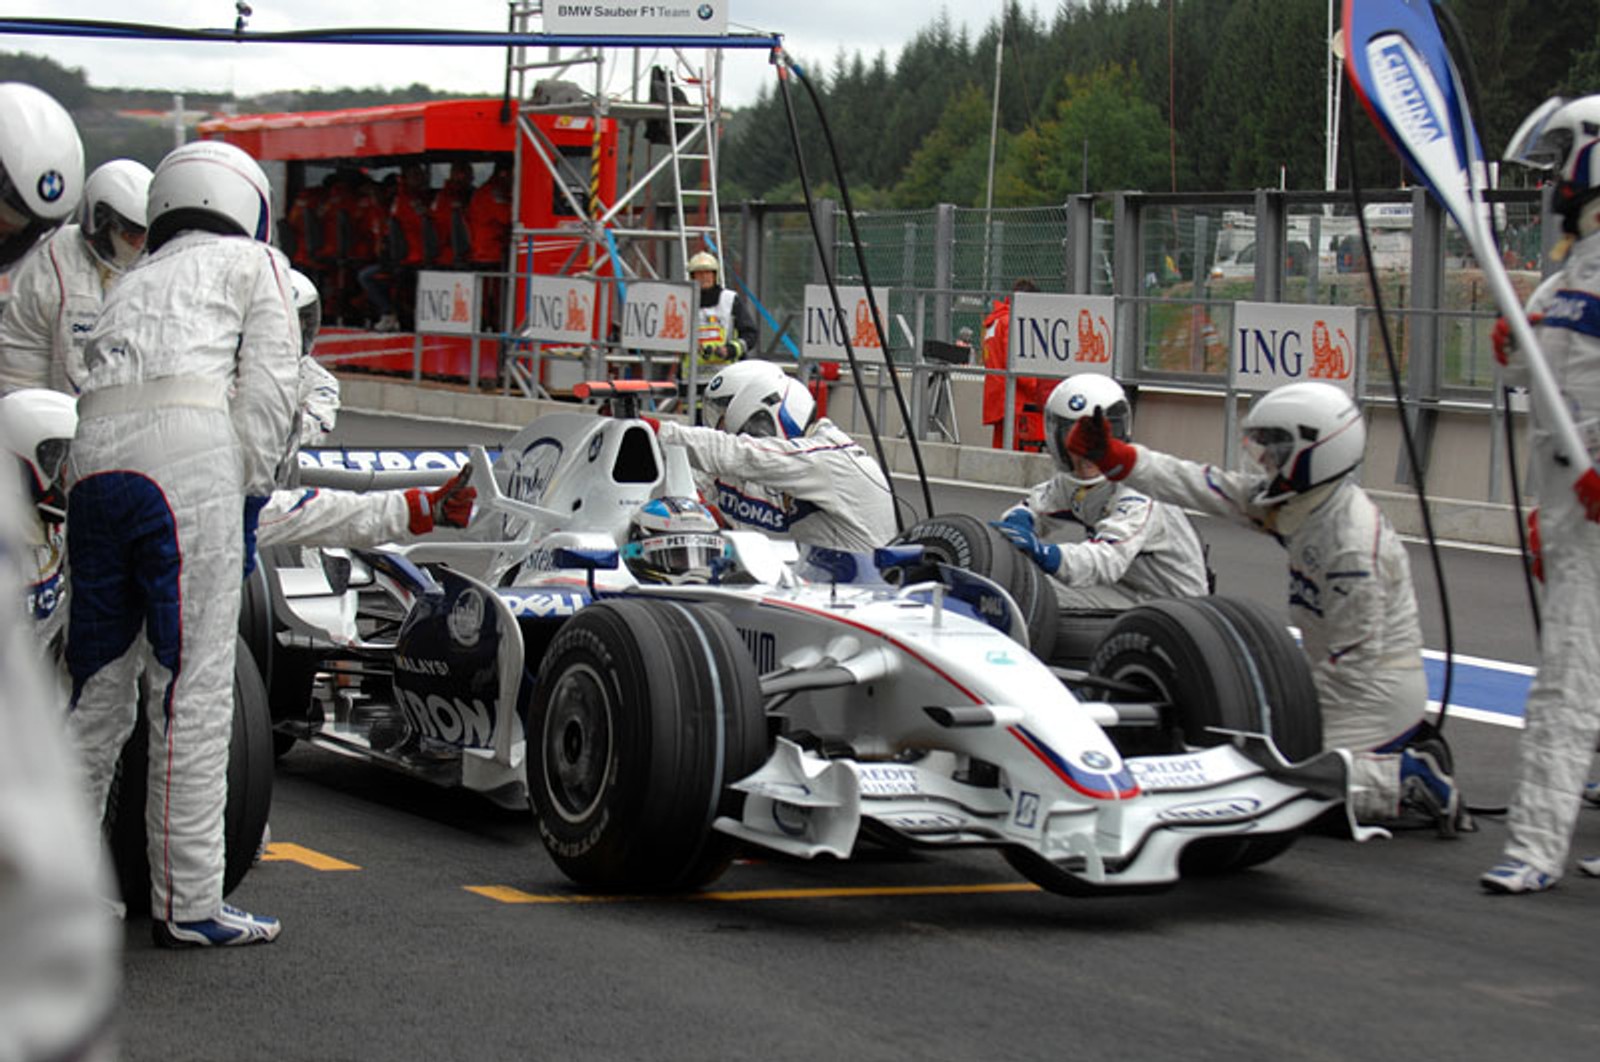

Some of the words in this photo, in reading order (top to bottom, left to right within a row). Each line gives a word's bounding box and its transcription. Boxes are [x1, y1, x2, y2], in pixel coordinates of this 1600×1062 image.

[558, 5, 592, 17] BMW
[594, 5, 638, 17] Sauber
[640, 6, 656, 17] F1
[657, 6, 691, 17] Team
[420, 289, 450, 322] ING
[529, 295, 563, 331] ING
[624, 301, 658, 338] ING
[806, 306, 848, 346] ING
[1018, 316, 1070, 361] ING
[1238, 327, 1303, 378] ING
[501, 593, 584, 617] DELL
